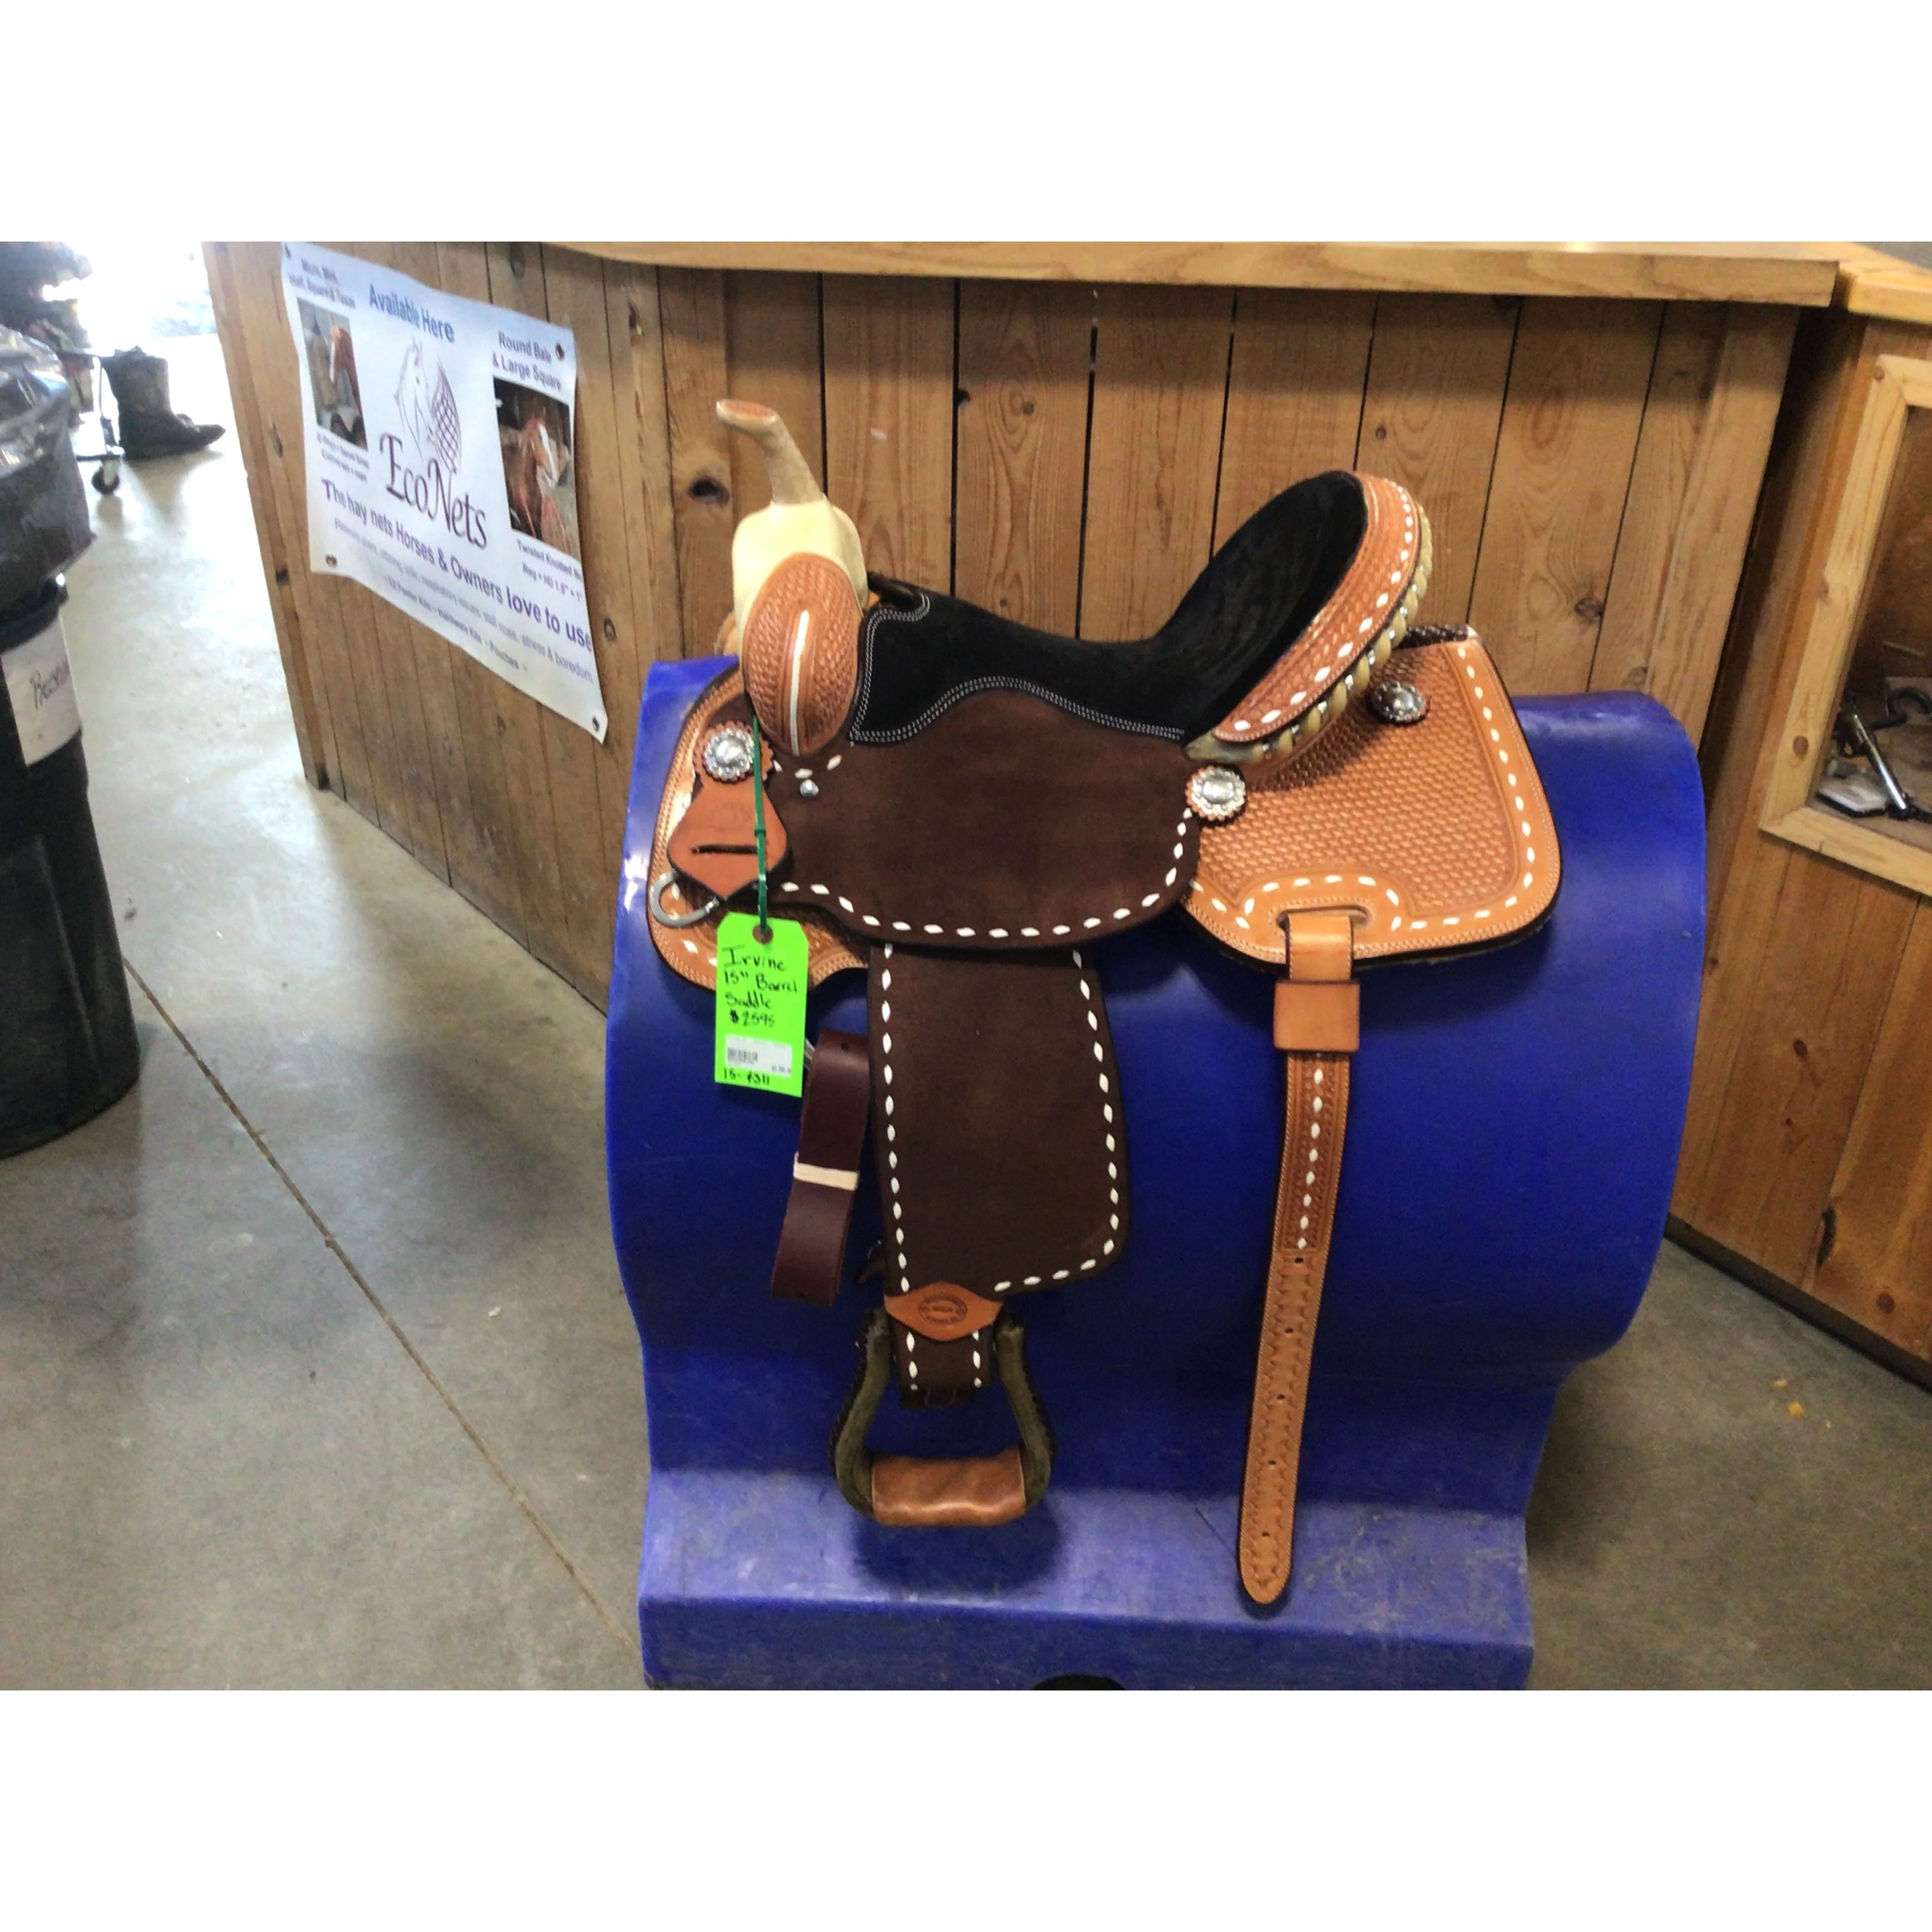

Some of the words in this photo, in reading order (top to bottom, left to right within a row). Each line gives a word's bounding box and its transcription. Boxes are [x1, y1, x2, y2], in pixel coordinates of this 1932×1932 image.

[369, 284, 420, 330] Available
[421, 307, 455, 343] Here
[498, 330, 532, 356] Round
[533, 342, 552, 365] Bale
[492, 351, 499, 369] &
[501, 353, 530, 381] Large
[533, 363, 562, 392] Square
[379, 432, 487, 549] EcoNets
[321, 478, 346, 508] The
[346, 490, 367, 526] hay
[371, 509, 394, 539] nets
[395, 519, 435, 565] Horses
[438, 547, 449, 573] &
[450, 555, 503, 605] Owners
[506, 585, 542, 624] love
[545, 606, 560, 635] to
[565, 621, 592, 653] use
[547, 646, 553, 662] &
[721, 944, 787, 971] Irvine
[724, 970, 749, 986] 15"
[755, 973, 797, 994] Barrel
[725, 989, 772, 1010] Saddle
